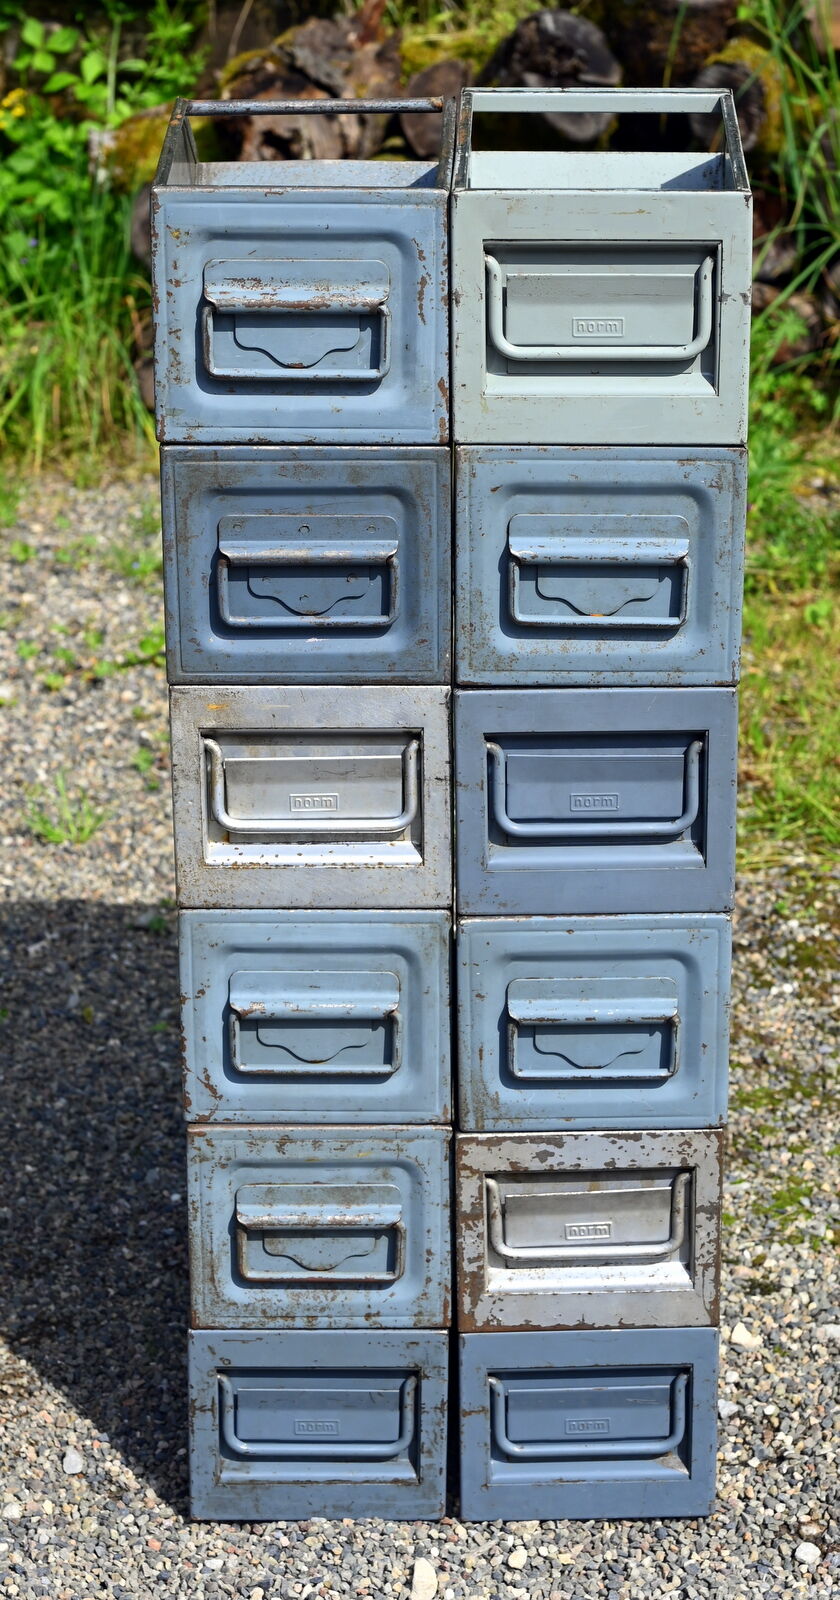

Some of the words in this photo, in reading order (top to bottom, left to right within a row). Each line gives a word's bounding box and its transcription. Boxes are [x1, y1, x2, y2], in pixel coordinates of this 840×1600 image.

[576, 320, 619, 333] norm
[294, 797, 334, 809] norm
[574, 796, 614, 808] norm
[568, 1225, 608, 1237] norm
[297, 1421, 336, 1433] norm
[568, 1420, 606, 1432] norm
